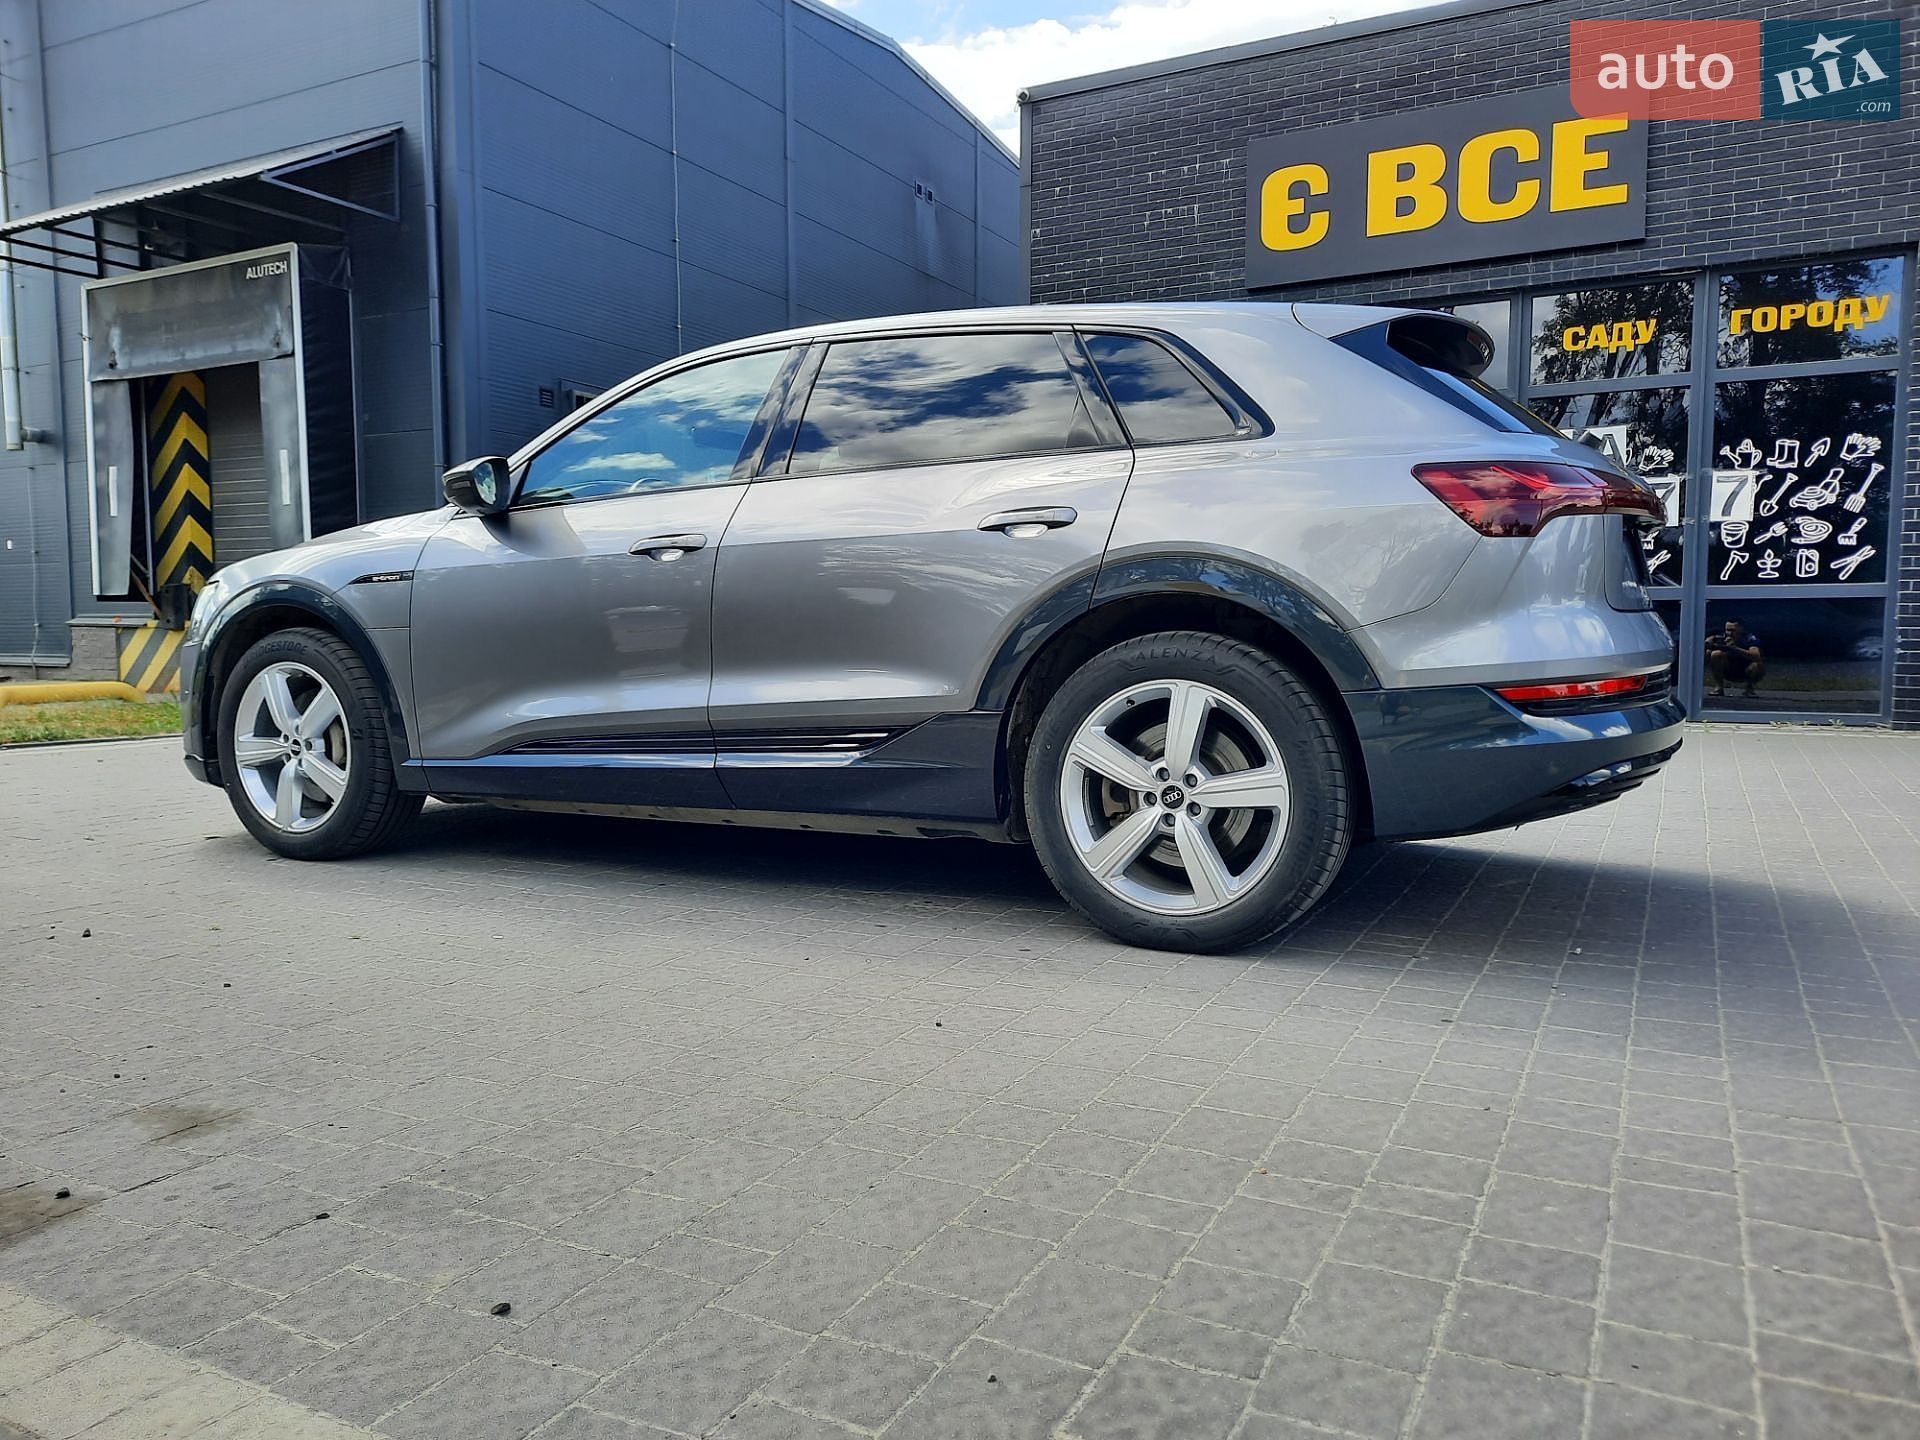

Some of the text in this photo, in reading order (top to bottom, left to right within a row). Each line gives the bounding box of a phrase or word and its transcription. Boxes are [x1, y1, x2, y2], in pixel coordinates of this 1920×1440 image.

[1259, 111, 1630, 252] Є ВСЕ
[245, 260, 288, 280] ALUTECH
[1562, 293, 1892, 354] САДУ ГОРОДУ
[1135, 647, 1217, 665] ALENZA
